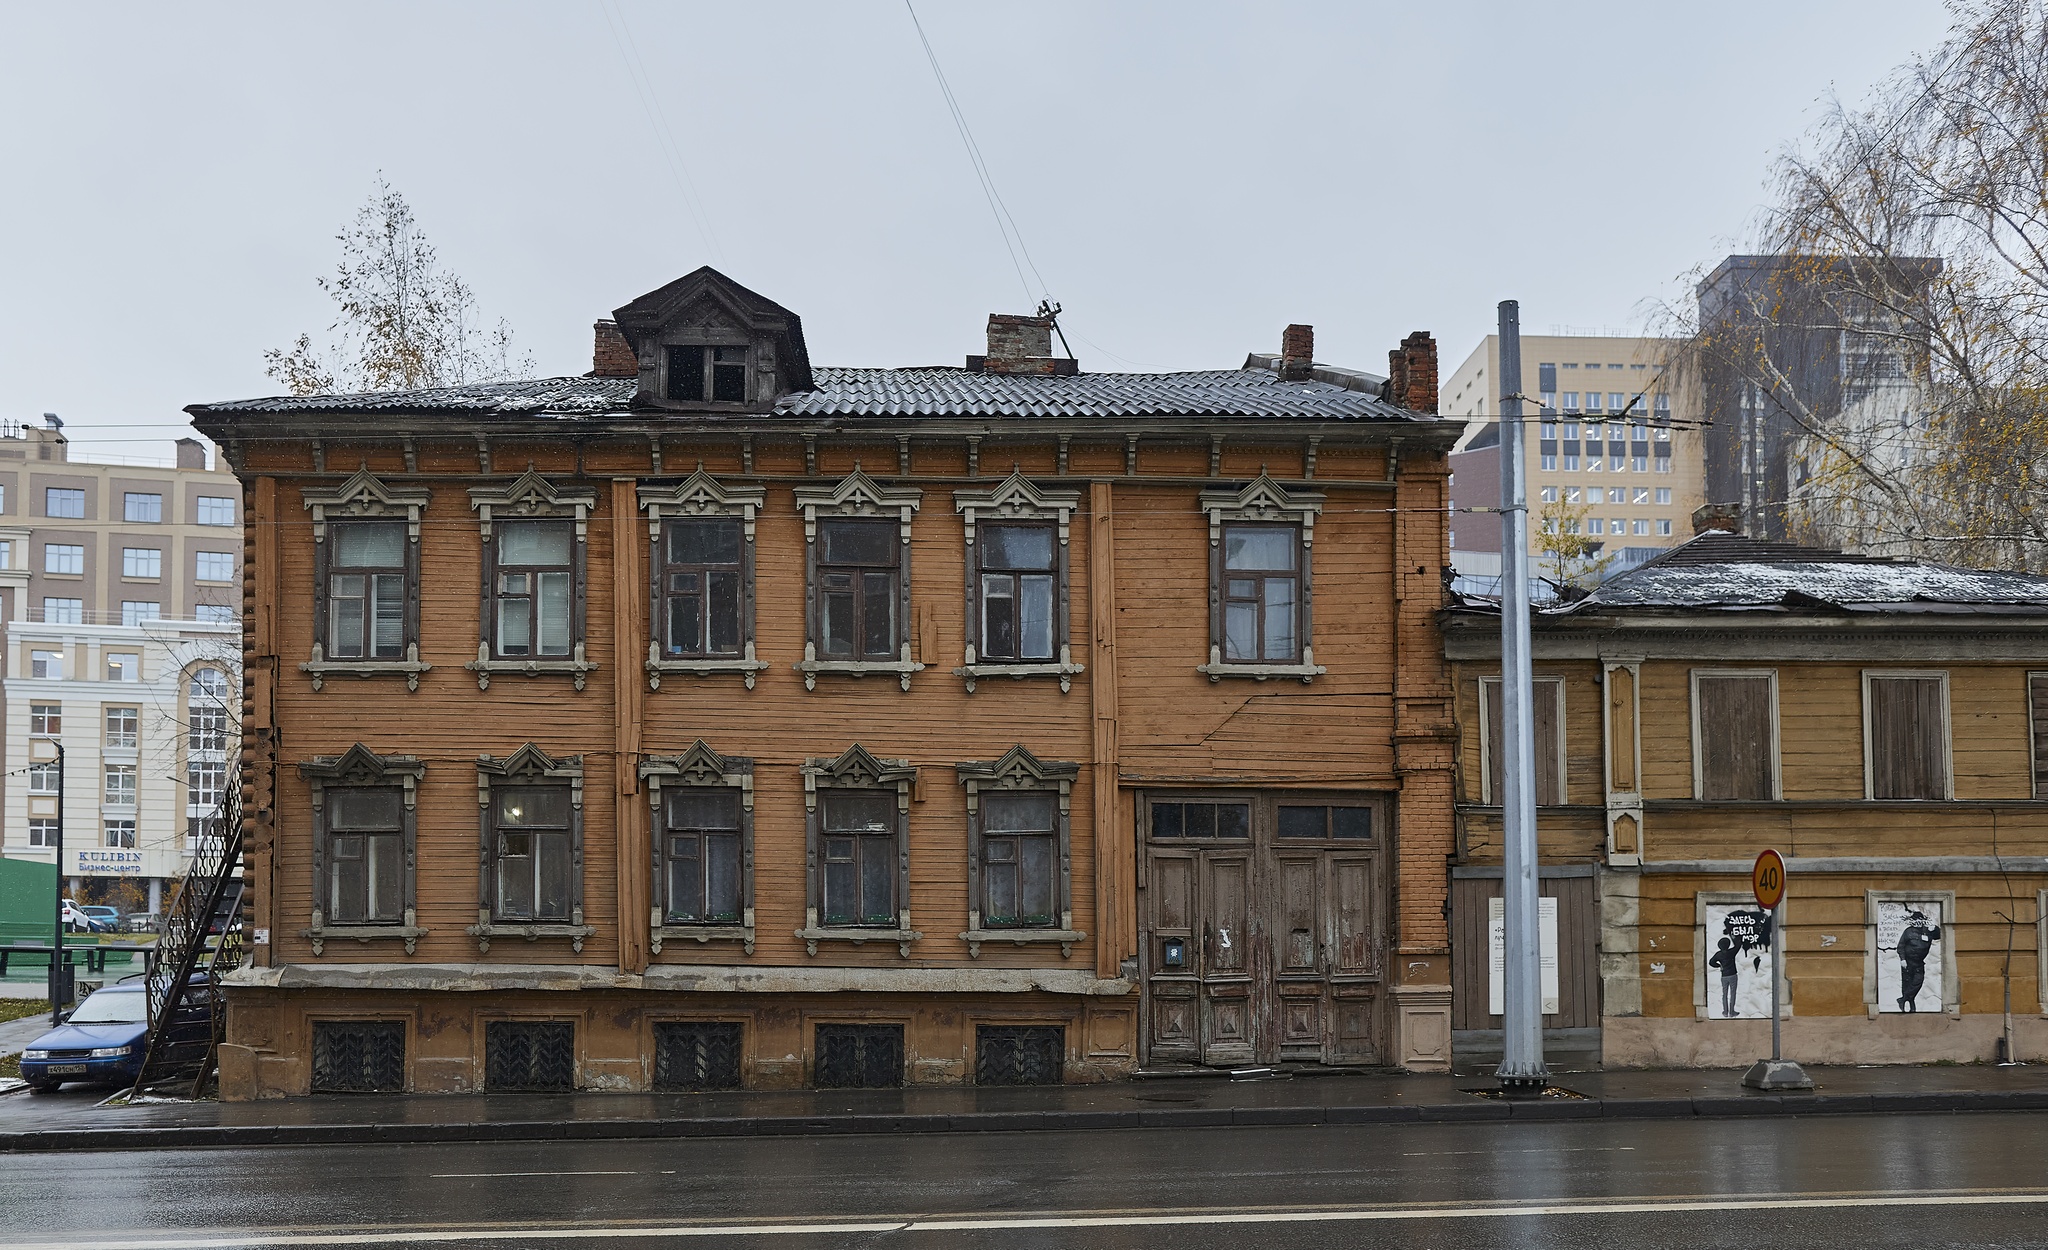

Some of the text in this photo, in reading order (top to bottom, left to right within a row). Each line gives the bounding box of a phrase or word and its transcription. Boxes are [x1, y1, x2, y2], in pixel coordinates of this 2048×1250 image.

[79, 852, 142, 861] KULIBIN
[79, 863, 141, 874] Бизнес-центр
[1760, 867, 1778, 890] 40
[1729, 915, 1756, 925] ЗДЕСЬ
[1733, 926, 1754, 935] БЫЛ
[1742, 934, 1759, 943] МЭР
